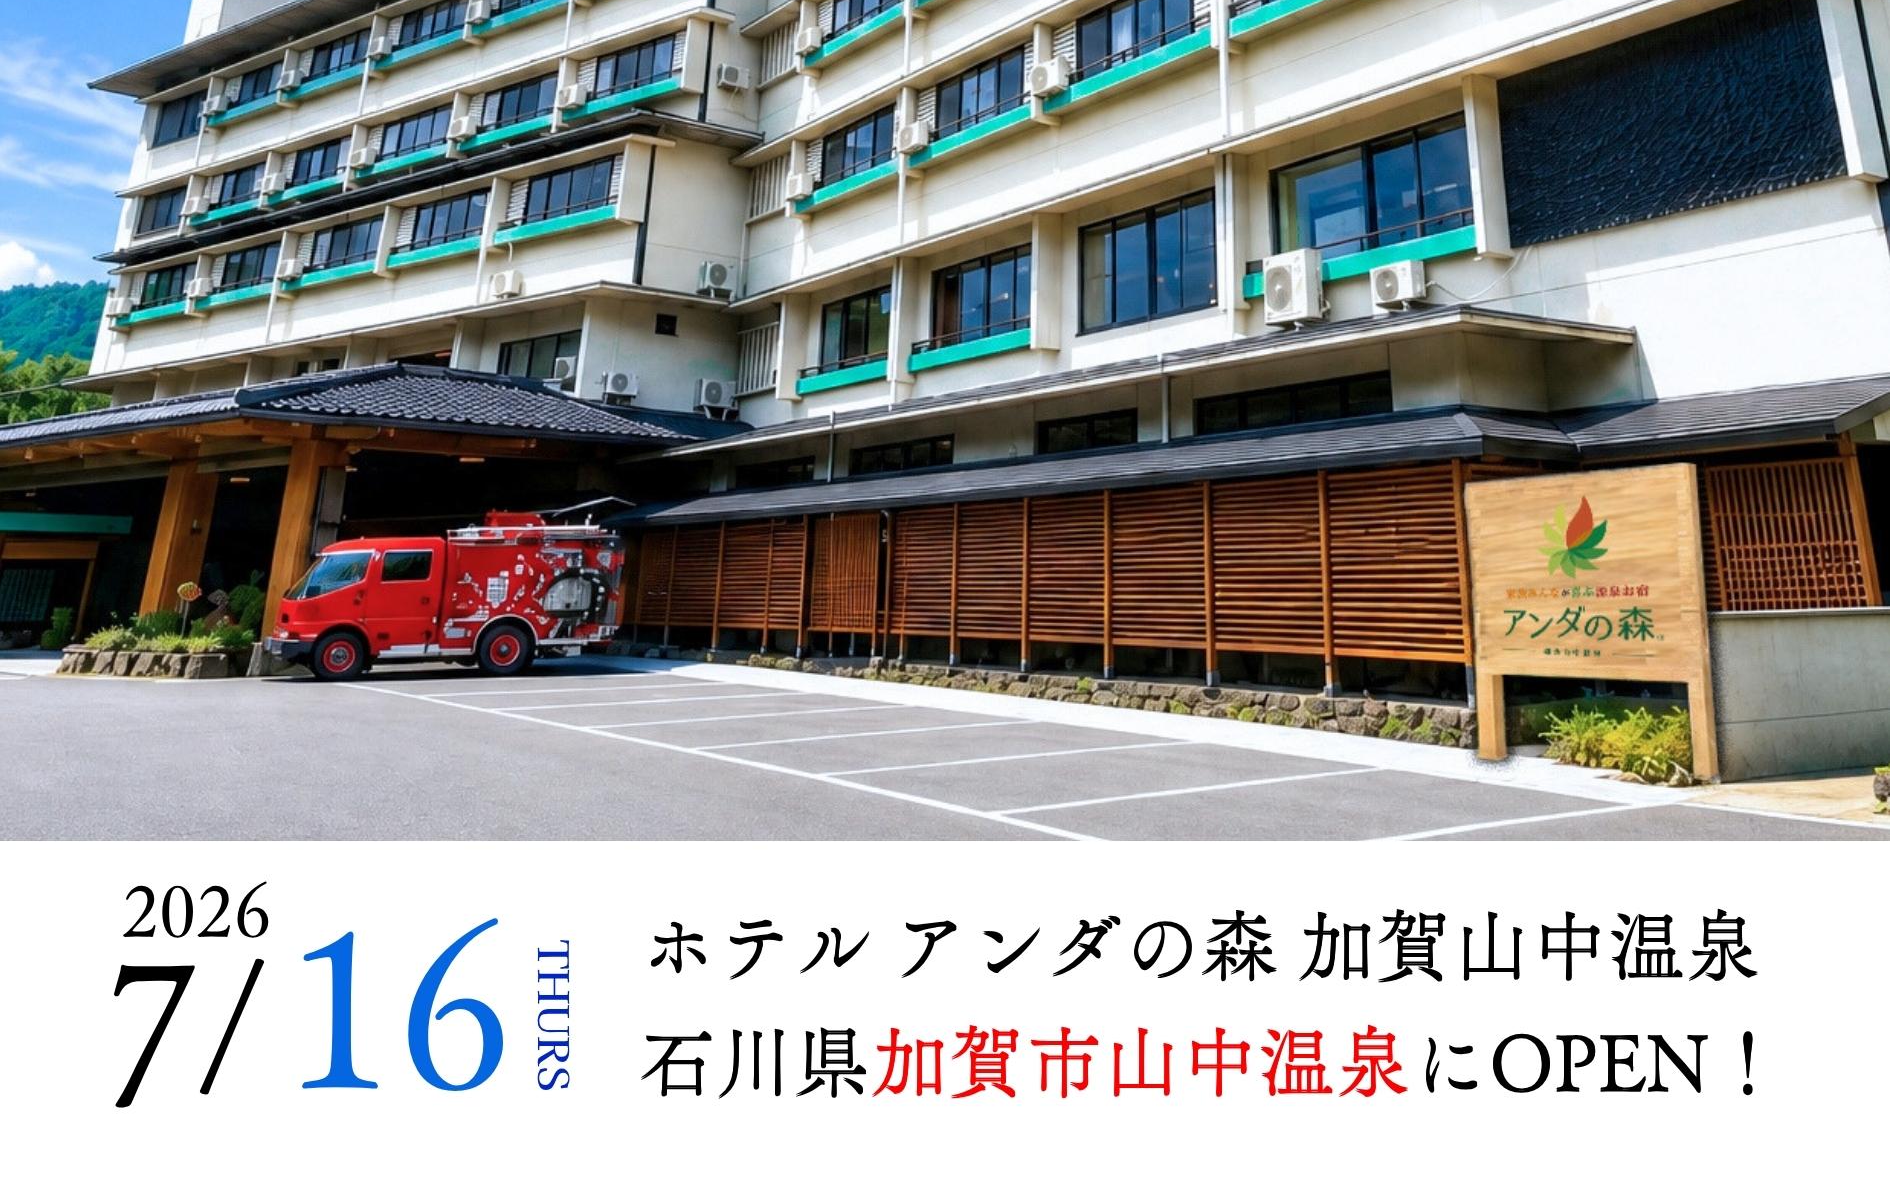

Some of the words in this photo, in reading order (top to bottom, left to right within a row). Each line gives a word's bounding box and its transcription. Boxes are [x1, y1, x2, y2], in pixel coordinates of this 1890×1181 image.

[1503, 606, 1655, 641] アンダの森
